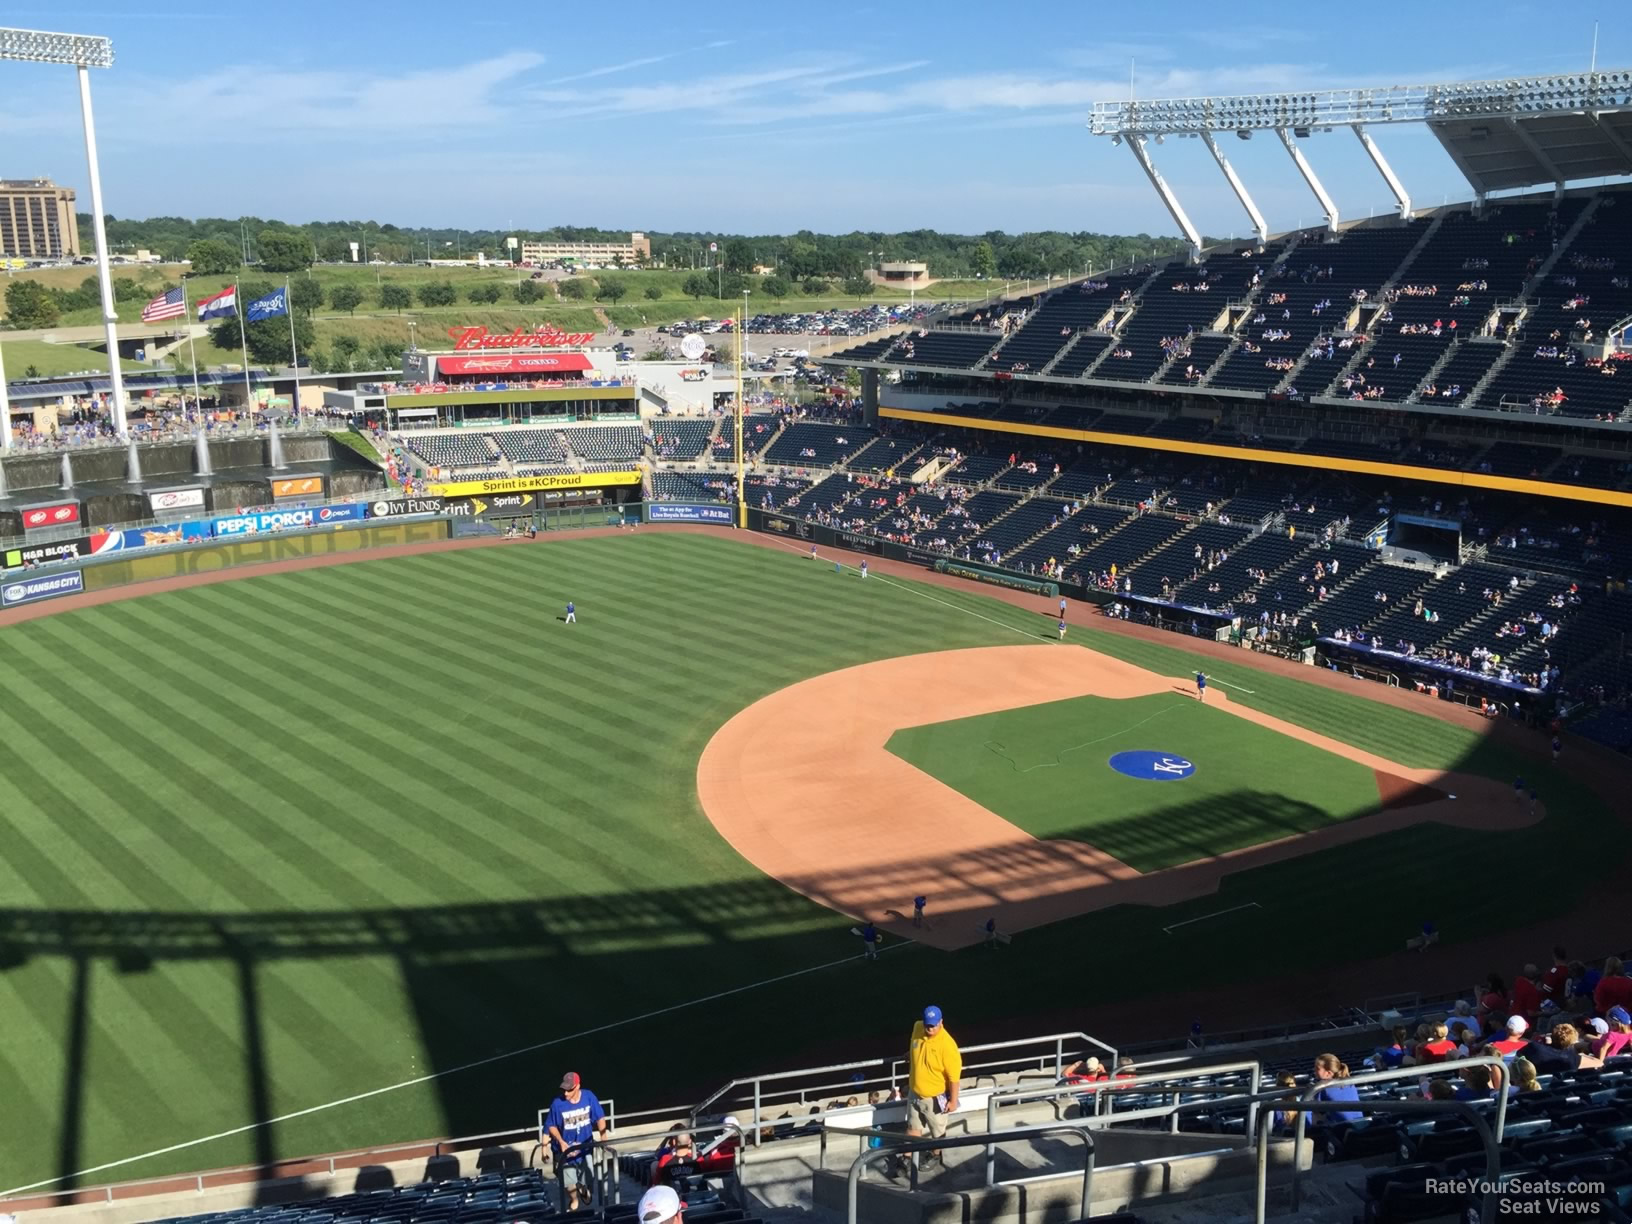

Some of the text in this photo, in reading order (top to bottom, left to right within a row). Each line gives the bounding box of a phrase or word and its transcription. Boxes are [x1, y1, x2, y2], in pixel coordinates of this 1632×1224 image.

[448, 326, 595, 350] Budweiser
[483, 476, 582, 491] Sprint is #KCProud
[389, 500, 441, 514] IVY FUNDS
[493, 496, 521, 507] Sprint
[332, 509, 351, 518] pepsi
[718, 511, 730, 519] Bat
[217, 510, 313, 534] PEPSI PORCH
[23, 543, 79, 560] H&R BLOCK
[27, 579, 60, 595] KANSAS
[60, 576, 80, 588] CITY
